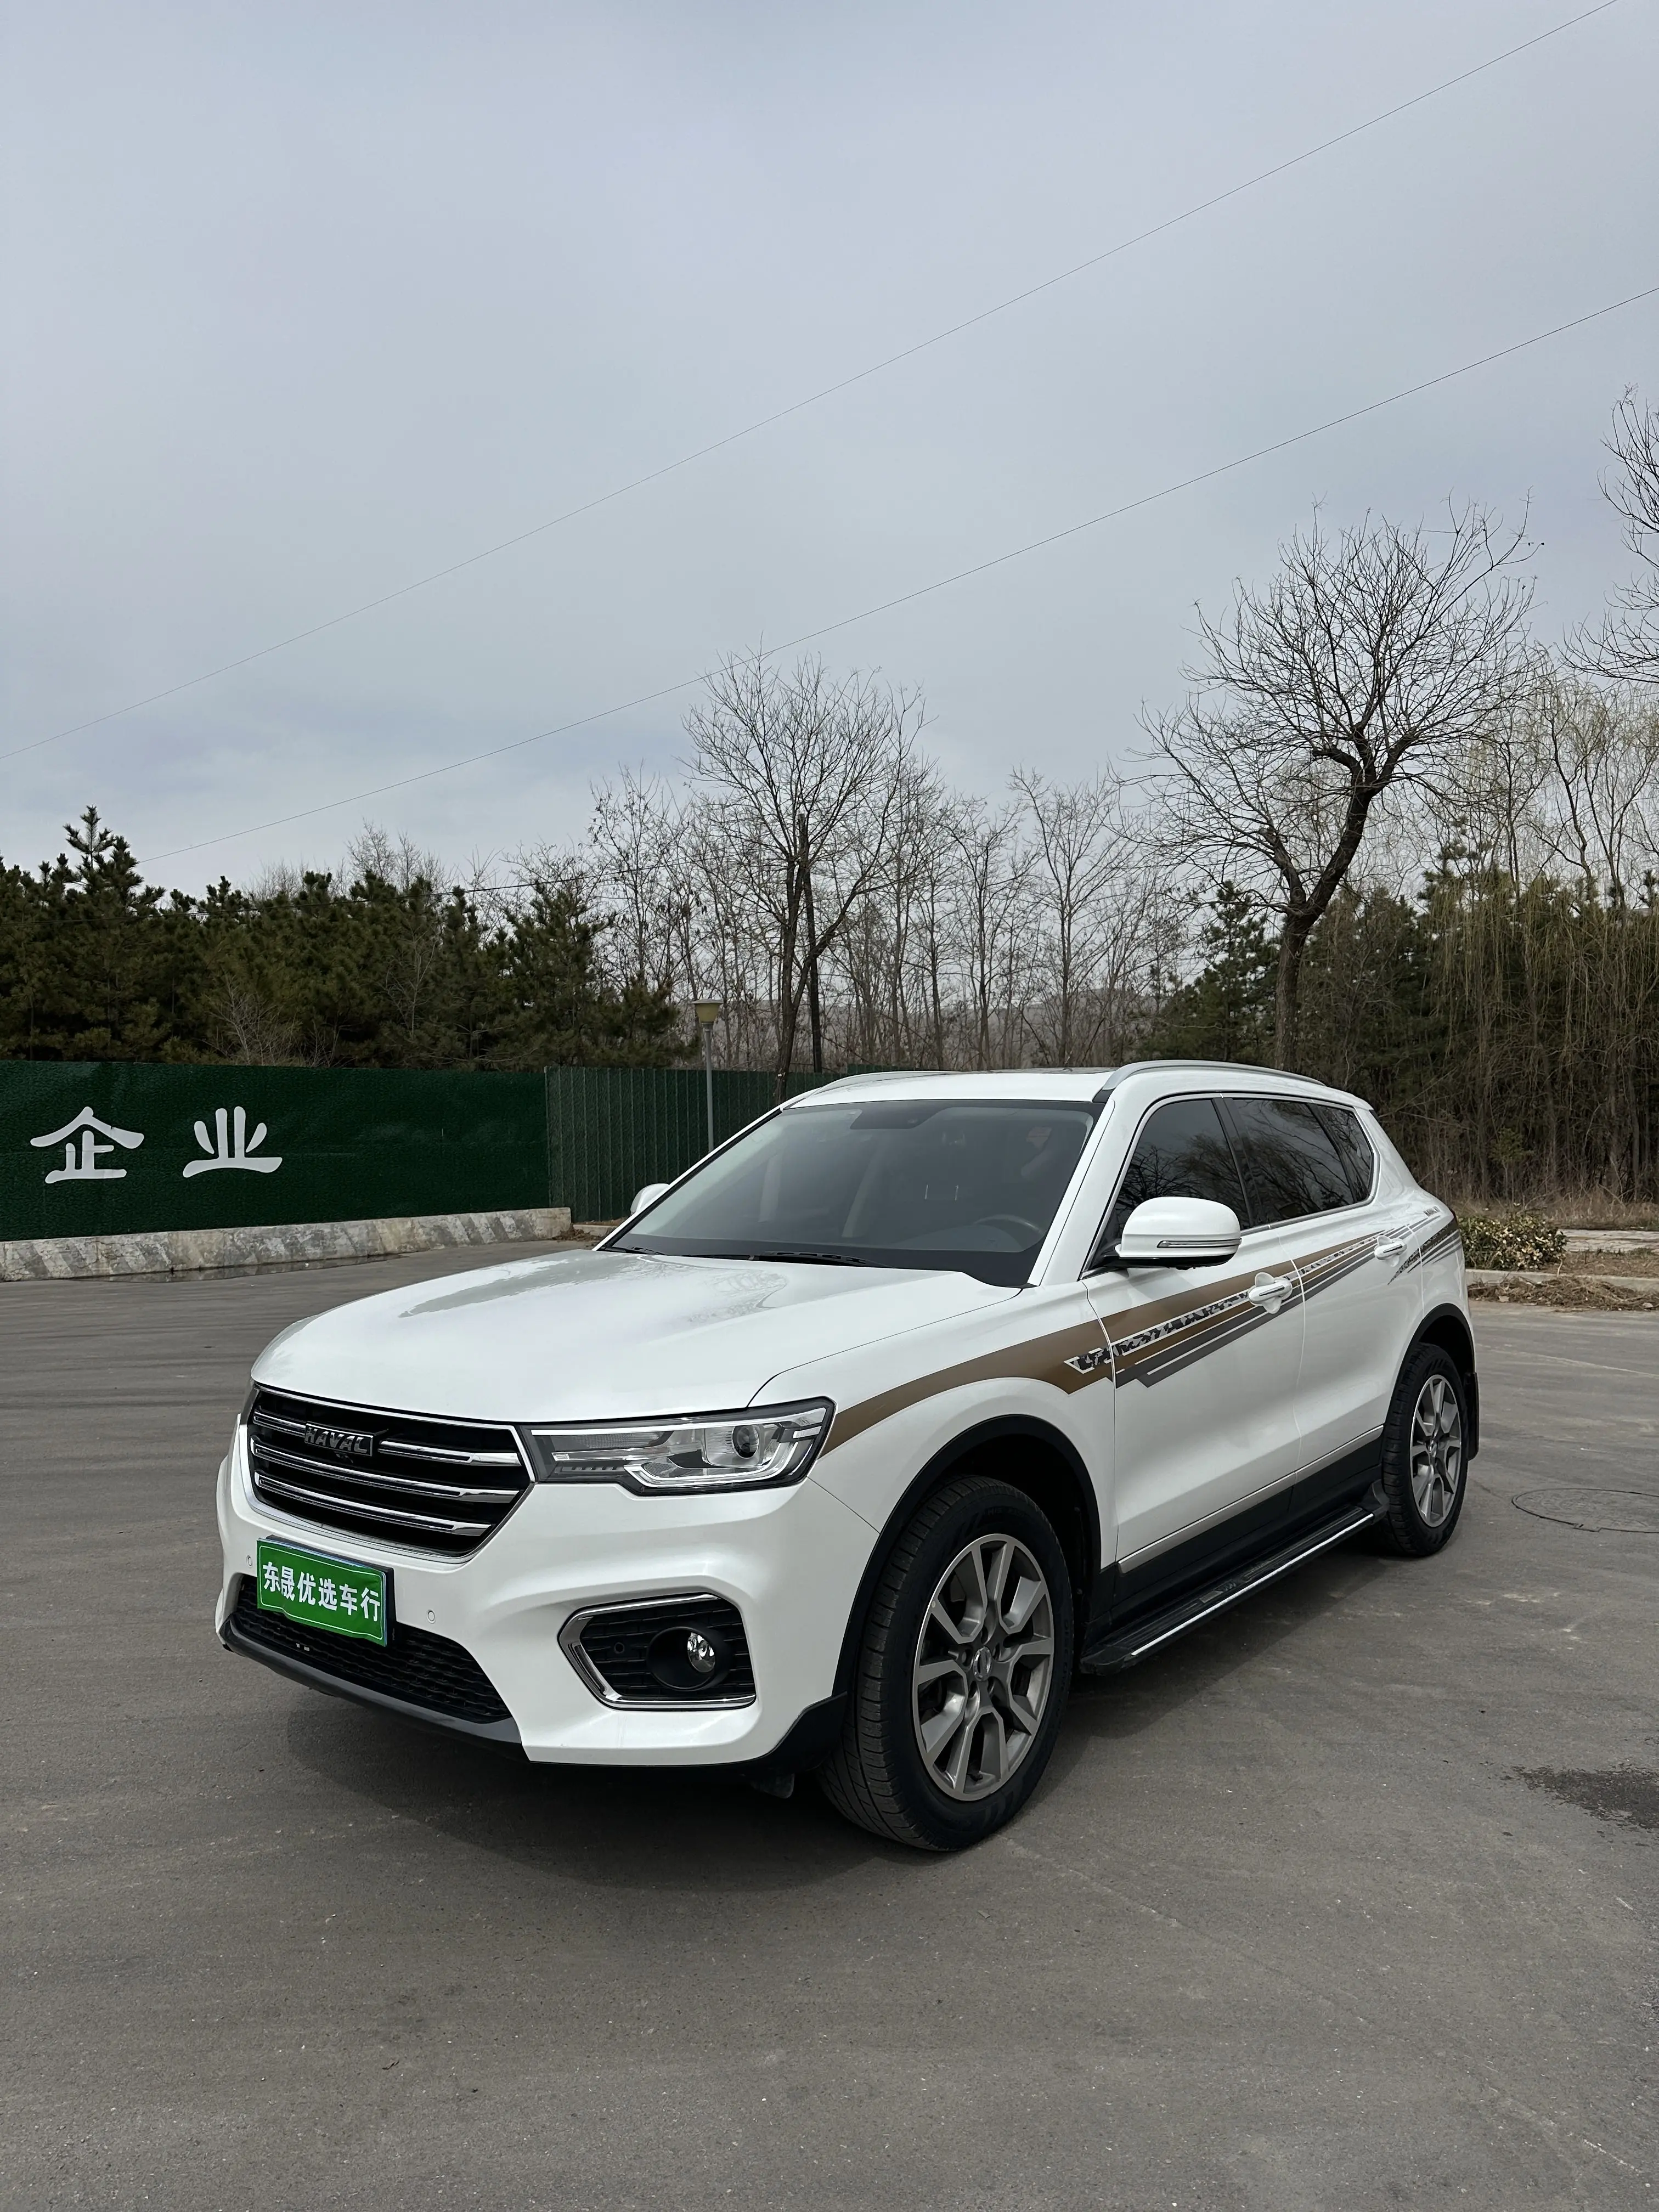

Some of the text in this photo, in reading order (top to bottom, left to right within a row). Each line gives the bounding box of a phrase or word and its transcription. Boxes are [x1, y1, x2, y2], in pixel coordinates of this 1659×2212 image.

[30, 1106, 283, 1183] 企业
[304, 1427, 368, 1453] HAVAL
[263, 1561, 380, 1622] 东晟优选车行
